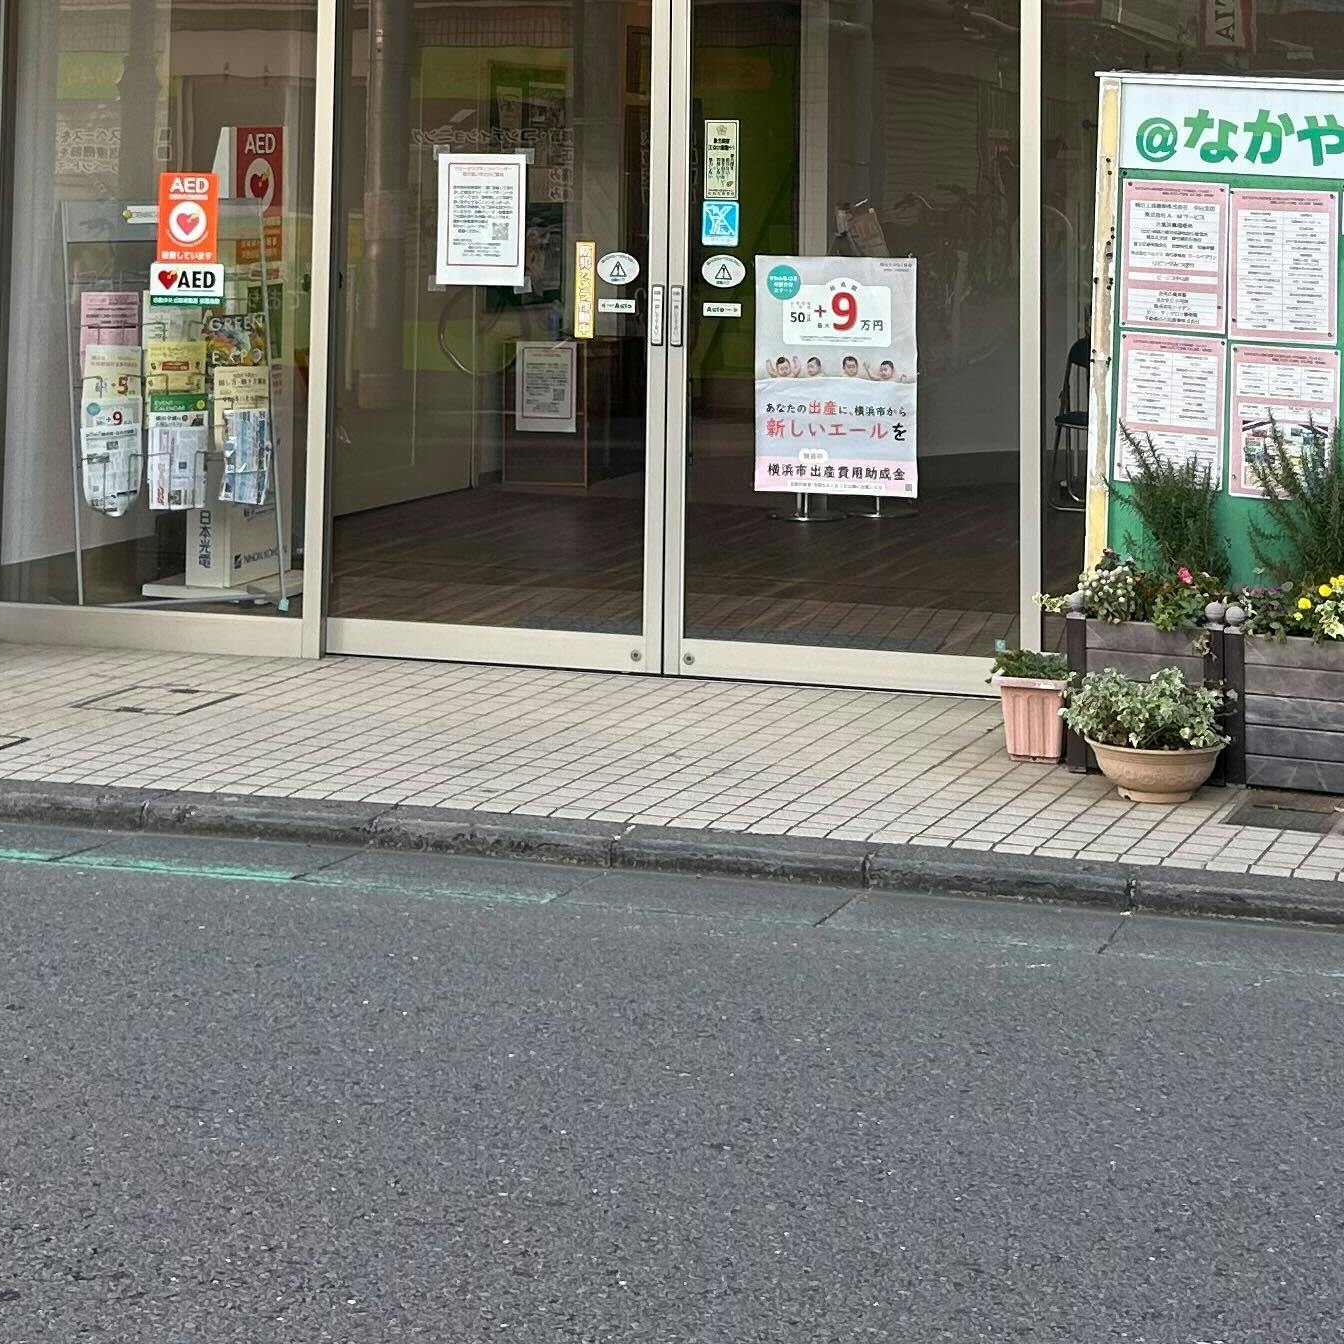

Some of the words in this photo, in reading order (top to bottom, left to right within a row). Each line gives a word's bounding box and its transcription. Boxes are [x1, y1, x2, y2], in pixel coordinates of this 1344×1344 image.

[244, 133, 276, 154] AED
[169, 177, 210, 194] AED
[177, 269, 216, 290] AED
[766, 417, 908, 442] 新しいエールを
[198, 510, 212, 569] 日本光電
